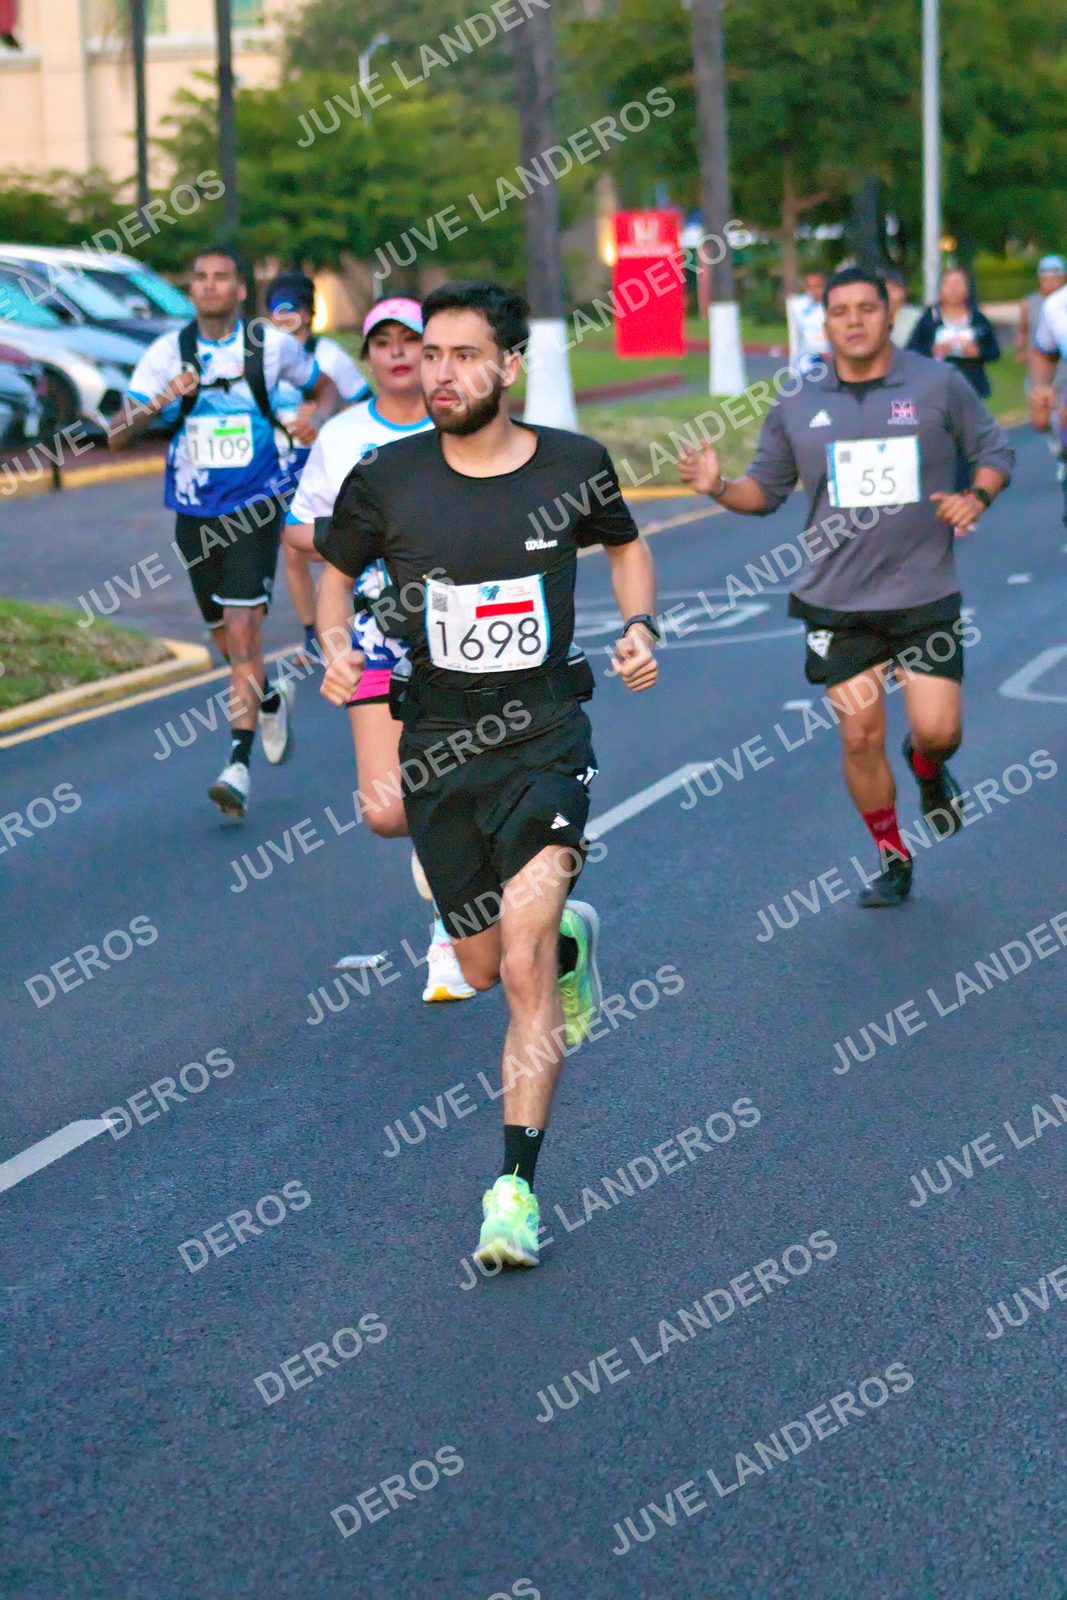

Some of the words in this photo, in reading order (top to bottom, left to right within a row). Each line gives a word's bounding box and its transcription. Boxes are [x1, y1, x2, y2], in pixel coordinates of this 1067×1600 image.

[192, 438, 250, 461] 1109
[859, 466, 896, 496] 55
[435, 617, 541, 661] 1698
